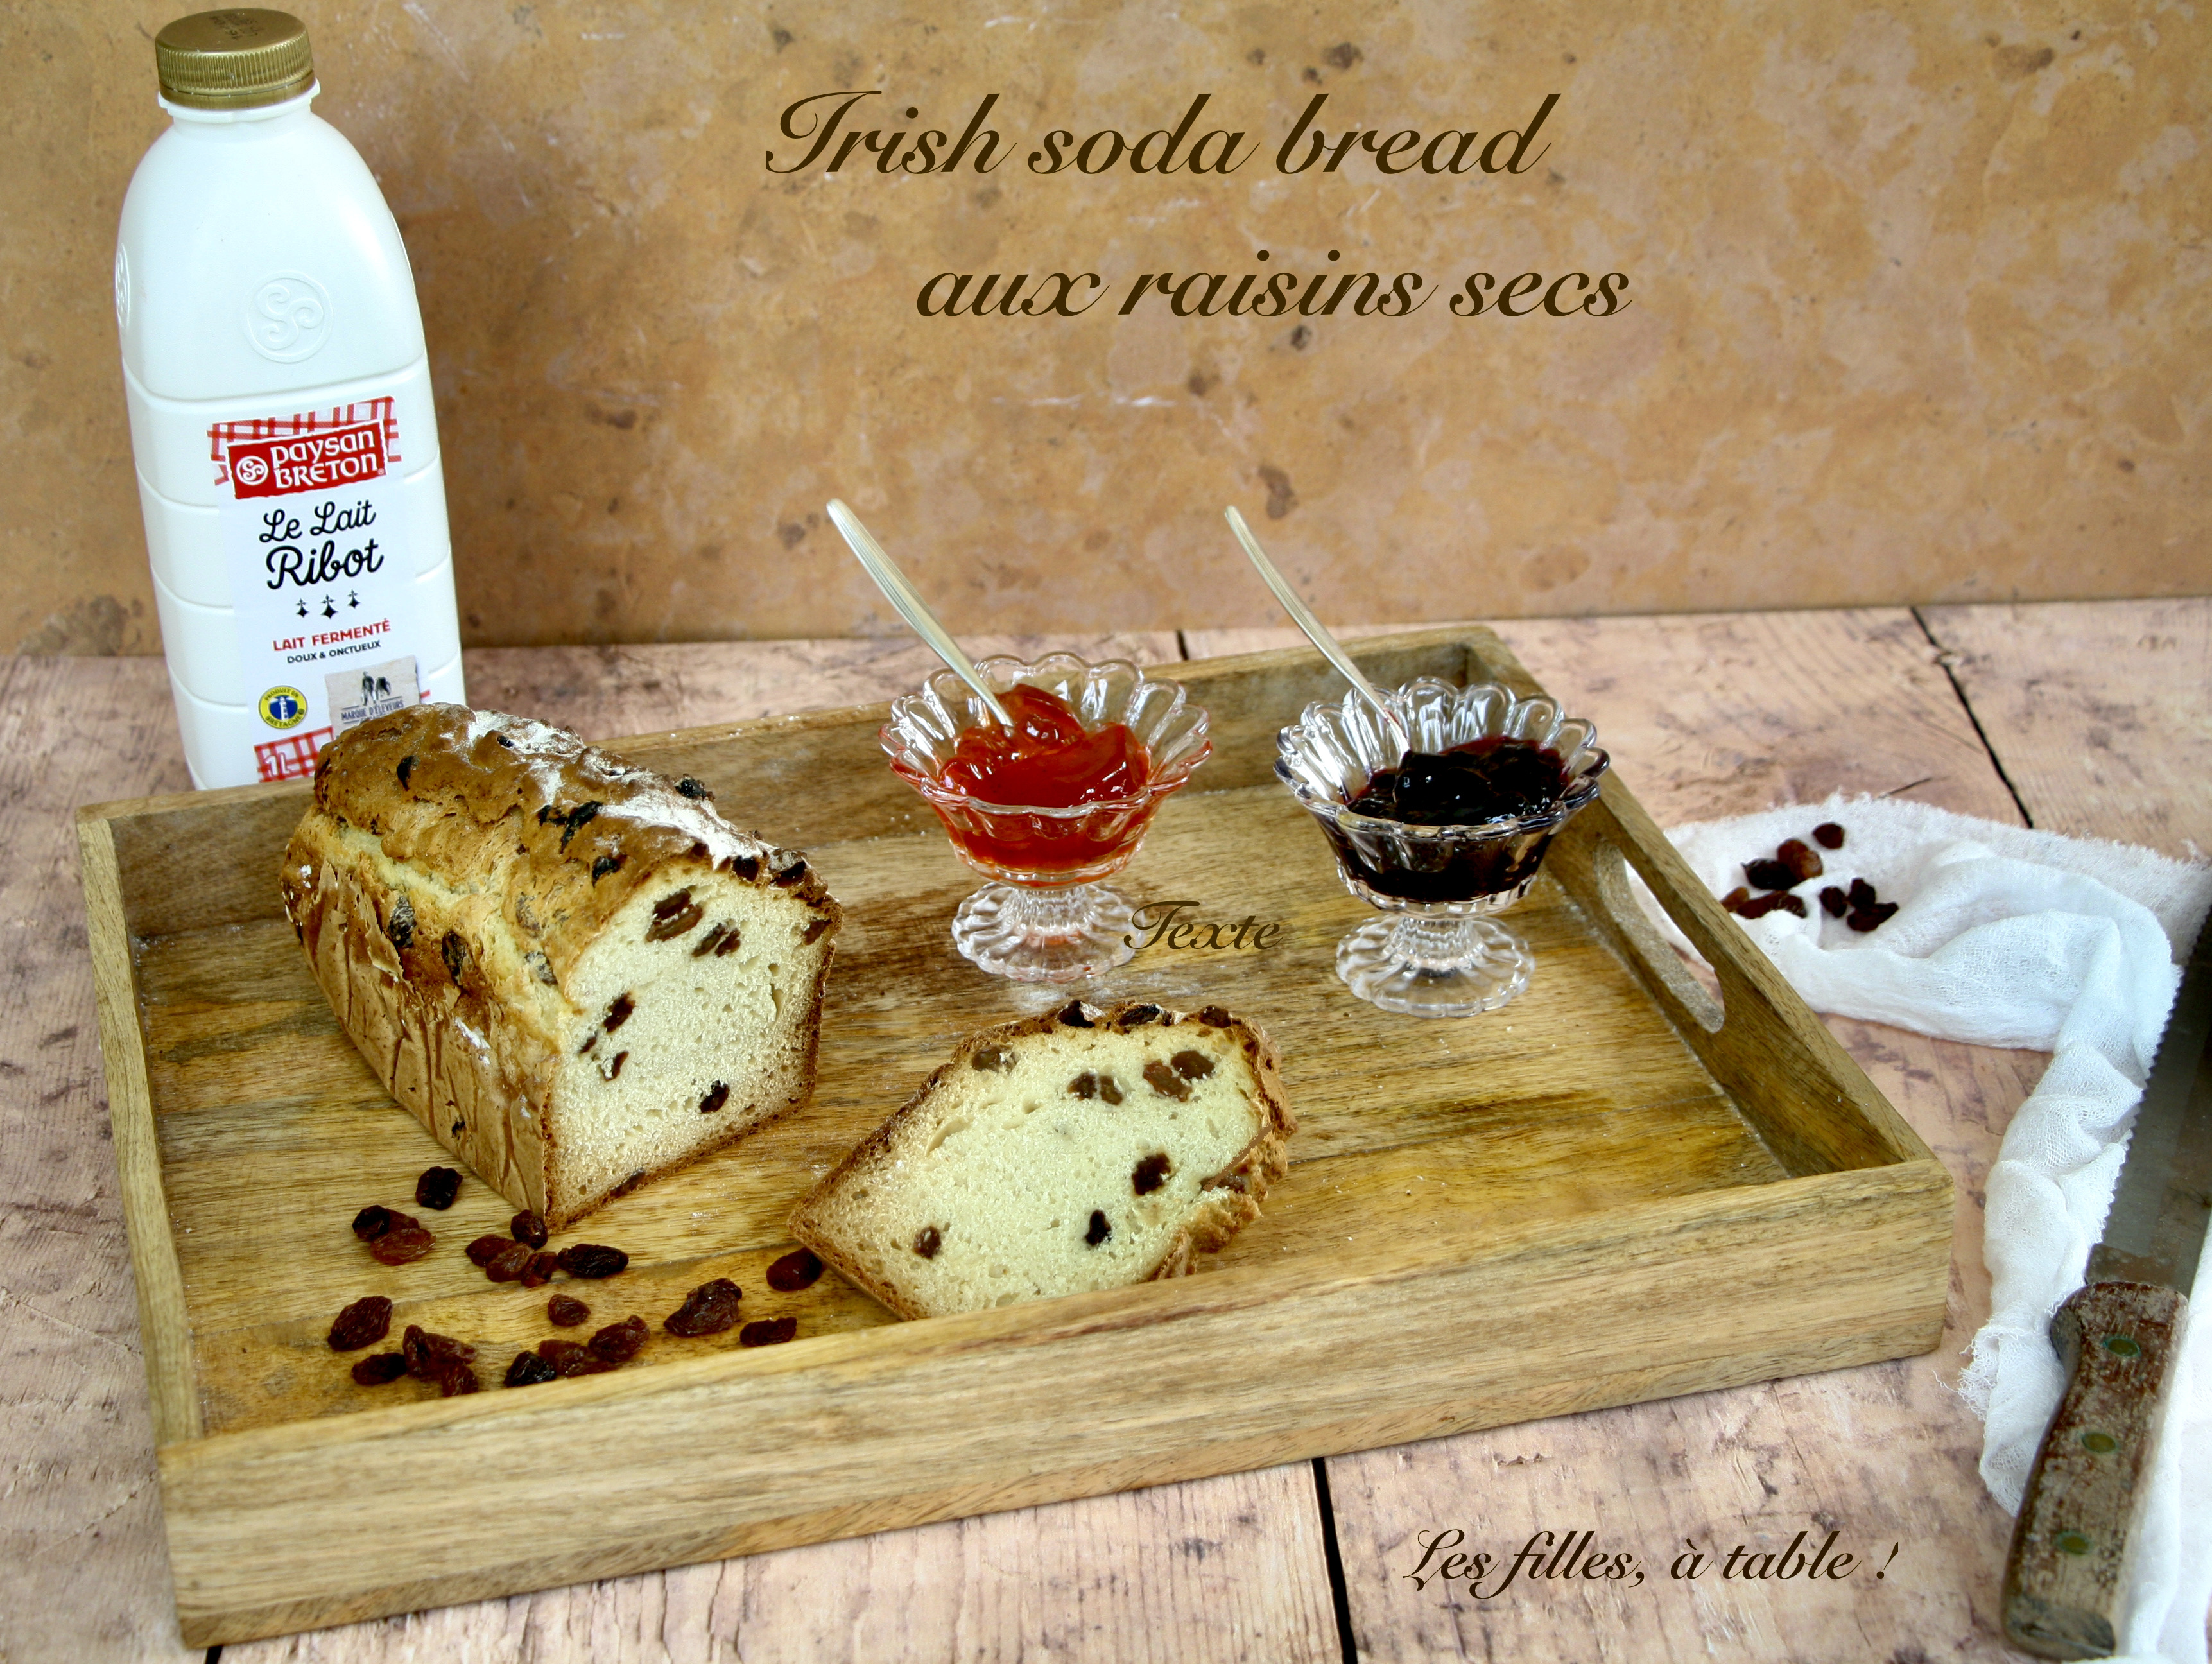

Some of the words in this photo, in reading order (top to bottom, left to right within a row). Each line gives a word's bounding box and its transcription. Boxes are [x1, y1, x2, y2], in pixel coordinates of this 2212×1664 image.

[259, 509, 303, 543] Le
[309, 500, 376, 536] Lait
[265, 538, 385, 589] Ribot
[273, 637, 306, 651] LAIT
[311, 618, 390, 646] FERMENTÉ
[287, 652, 317, 664] DOUX
[319, 651, 326, 659] &
[329, 639, 381, 657] ONCTUEUX
[341, 707, 367, 720] MARQUE
[263, 752, 291, 776] 1L
